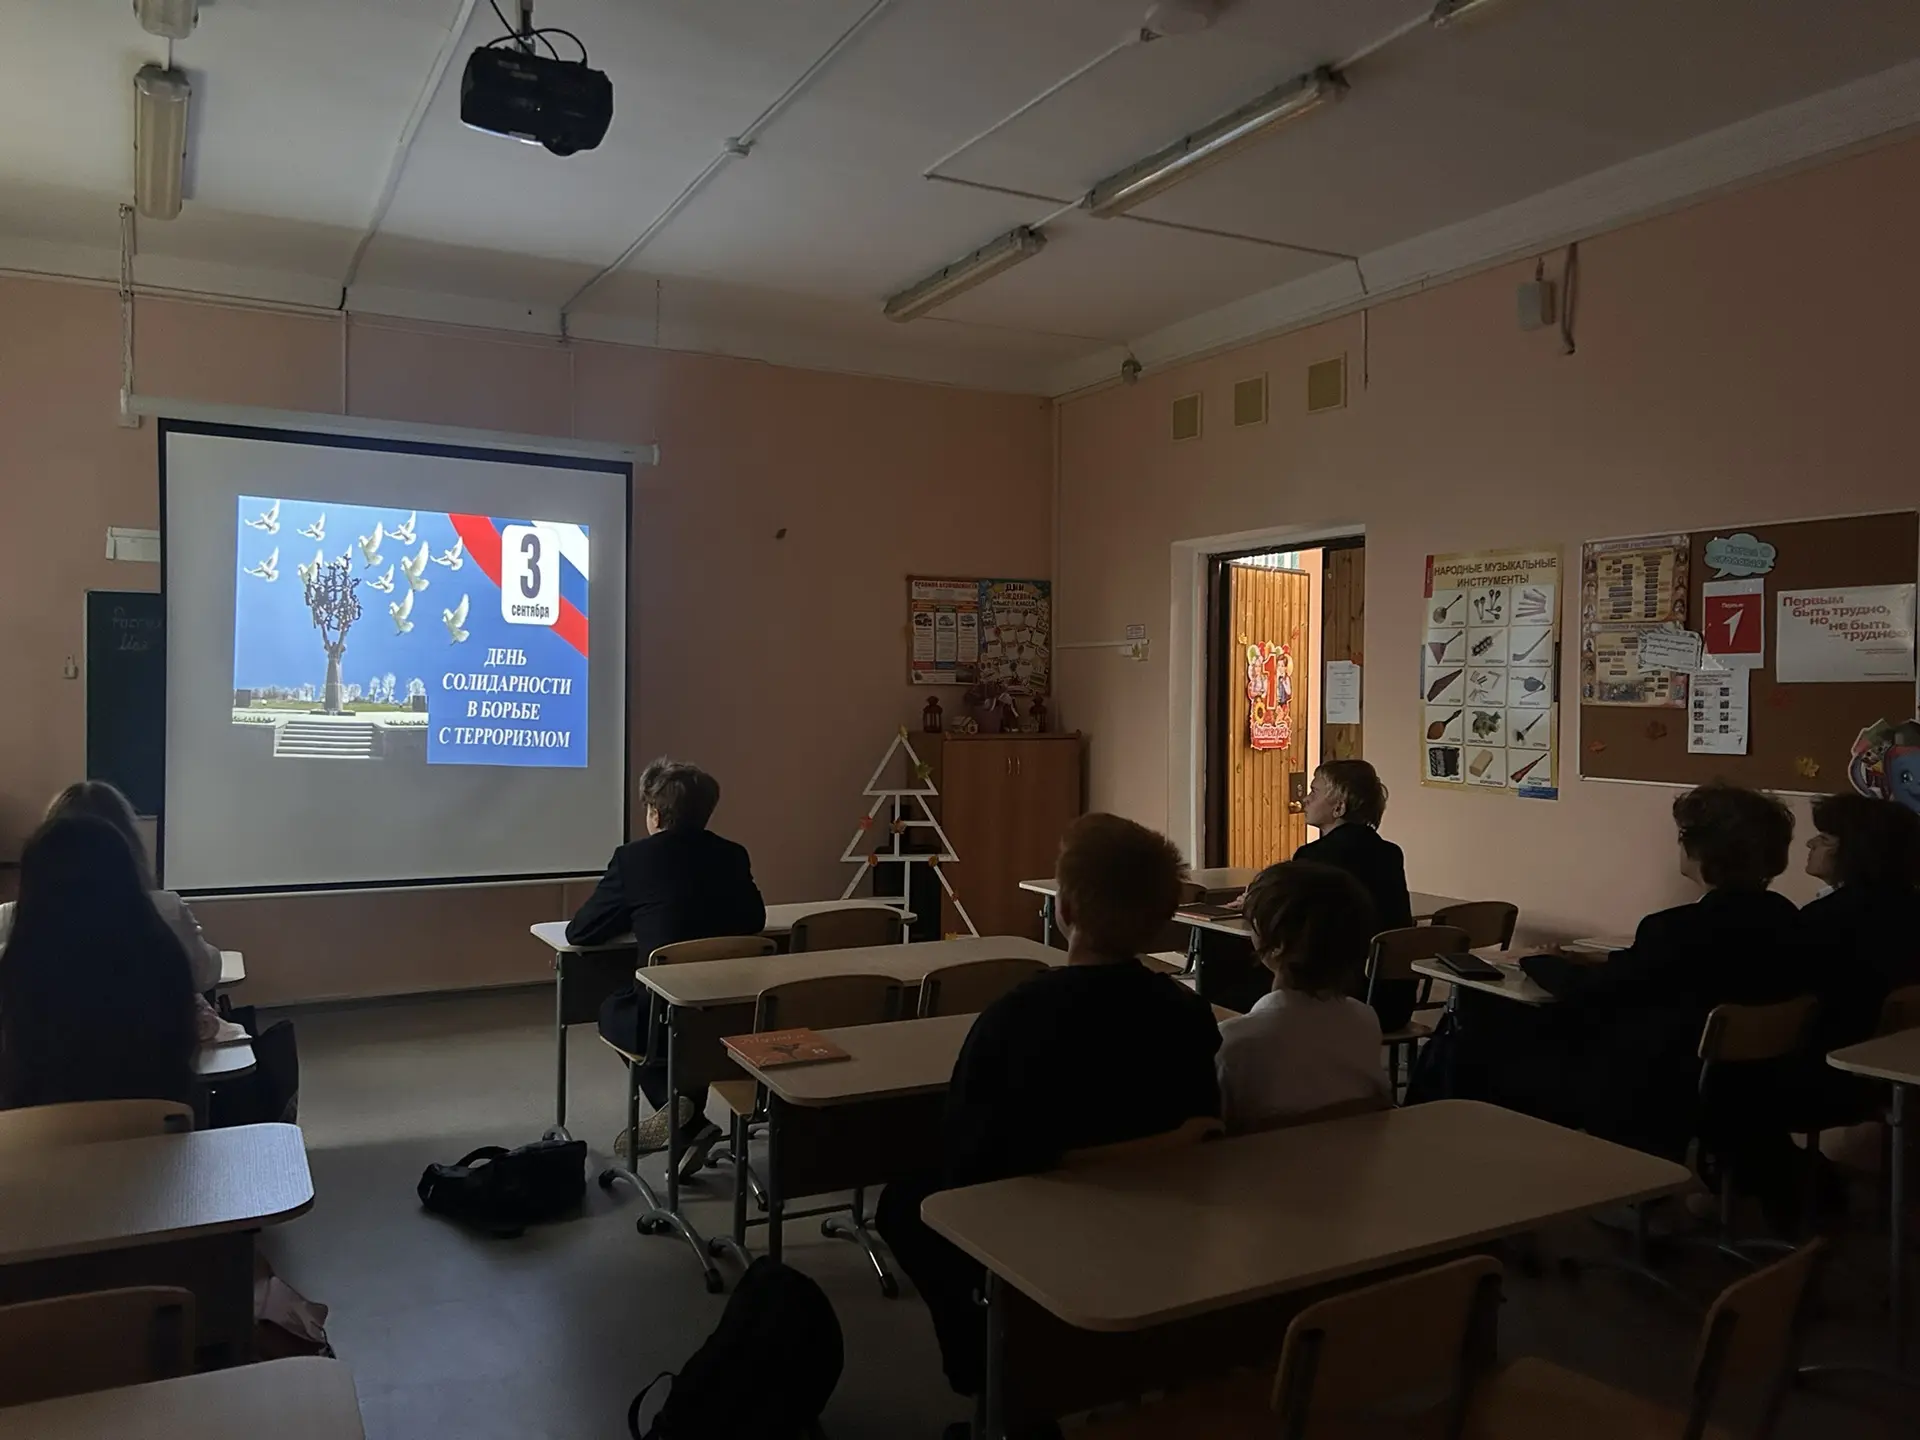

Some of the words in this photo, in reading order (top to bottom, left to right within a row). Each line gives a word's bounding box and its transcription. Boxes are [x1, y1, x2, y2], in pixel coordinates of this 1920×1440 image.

[519, 533, 541, 599] 3
[1434, 563, 1482, 576] НАРОДНЫЕ
[1484, 557, 1557, 572] МУЗЫКАЛЬНЫЕ
[1456, 574, 1529, 587] ИНСТРУМЕНТЫ
[511, 603, 550, 618] сентября
[1783, 596, 1844, 608] Первым
[1792, 606, 1831, 617] быть
[1833, 605, 1891, 617] трудно,
[1810, 617, 1829, 625] но
[1829, 622, 1848, 631] не
[1850, 619, 1891, 630] быть
[484, 648, 528, 668] ДЕНЬ
[442, 671, 573, 696] СОЛИДАРНОСТИ
[467, 700, 480, 717] В
[481, 702, 541, 721] БОРЬБЕ
[438, 726, 451, 744] С
[454, 727, 570, 749] ТЕРРОРИЗМОМ
